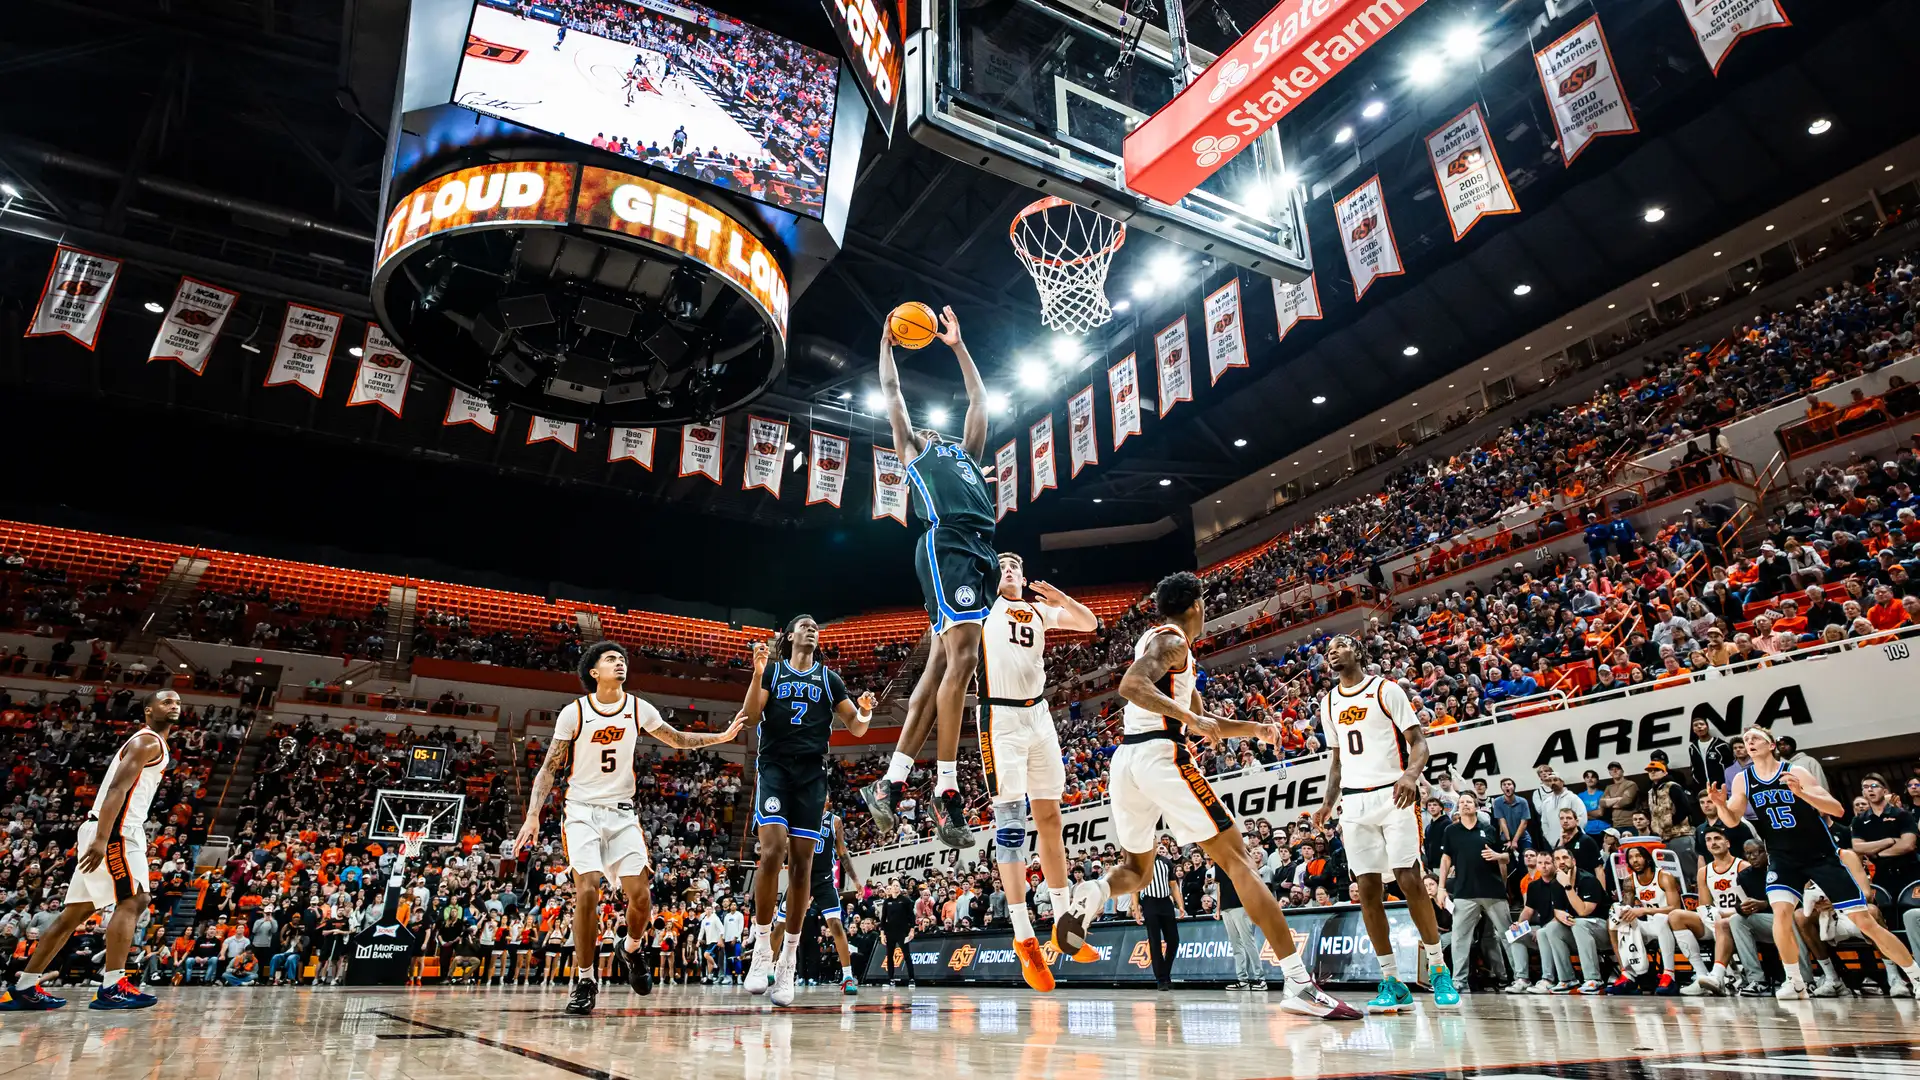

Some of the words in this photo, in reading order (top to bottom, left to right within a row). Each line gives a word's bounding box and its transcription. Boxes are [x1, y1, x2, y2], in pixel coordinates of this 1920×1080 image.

[1252, 0, 1336, 69] State
[1545, 38, 1598, 76] CHAMPIONS
[1555, 37, 1582, 59] NCAA
[1572, 90, 1597, 111] 2010
[1562, 120, 1584, 135] CROSS
[1585, 100, 1619, 123] COUNTRY
[1571, 99, 1604, 123] COWBOY
[1443, 122, 1467, 142] NCAA
[1587, 122, 1598, 132] 50
[1435, 124, 1480, 158] CHAMPIONS
[1459, 173, 1484, 191] 2009
[1459, 181, 1491, 201] COWBOY
[409, 171, 545, 230] LOUD
[1349, 192, 1368, 210] NCAA
[1452, 198, 1472, 213] CROSS
[1473, 182, 1501, 202] COUNTRY
[611, 183, 722, 250] GET
[1342, 194, 1378, 224] CHAMPIONS
[1360, 246, 1383, 265] COWBOY
[180, 292, 229, 311] CHAMPIONS
[195, 288, 220, 300] NCAA
[49, 313, 87, 325] WRESTLING
[54, 307, 87, 319] COWBOY
[302, 312, 326, 323] NCAA
[176, 327, 200, 340] 1966
[289, 317, 334, 333] CHAMPIONS
[165, 339, 200, 353] WRESTLING
[169, 334, 200, 347] COWBOY
[286, 359, 314, 369] COWBOY
[292, 352, 313, 363] 1968
[283, 364, 315, 375] WRESTLING
[373, 372, 392, 382] 1971
[364, 384, 396, 394] WRESTLING
[368, 379, 394, 389] COWBOY
[621, 436, 643, 446] COWBOY
[694, 444, 710, 454] 1983
[691, 451, 713, 460] COWBOY
[934, 443, 966, 460] BY
[820, 474, 835, 482] 1989
[956, 461, 977, 485] 3
[1008, 621, 1034, 648] 19
[1884, 642, 1910, 661] 109
[77, 685, 93, 694] 207
[776, 682, 823, 703] BYU
[790, 701, 808, 724] 7
[1338, 706, 1368, 726] OSU
[590, 725, 626, 745] OSU
[1533, 684, 1814, 769] ARENA
[1347, 729, 1364, 755] 0
[601, 749, 616, 773] 5
[980, 731, 993, 775] COWBOYS
[1180, 762, 1217, 807] COWBOYS
[1753, 789, 1795, 808] BYU
[1766, 806, 1796, 830] 15
[107, 841, 127, 880] COWBOYS
[870, 851, 935, 878] WELCOME
[1719, 893, 1736, 908] 22
[948, 944, 977, 972] OSU
[978, 949, 1016, 965] MEDICINE
